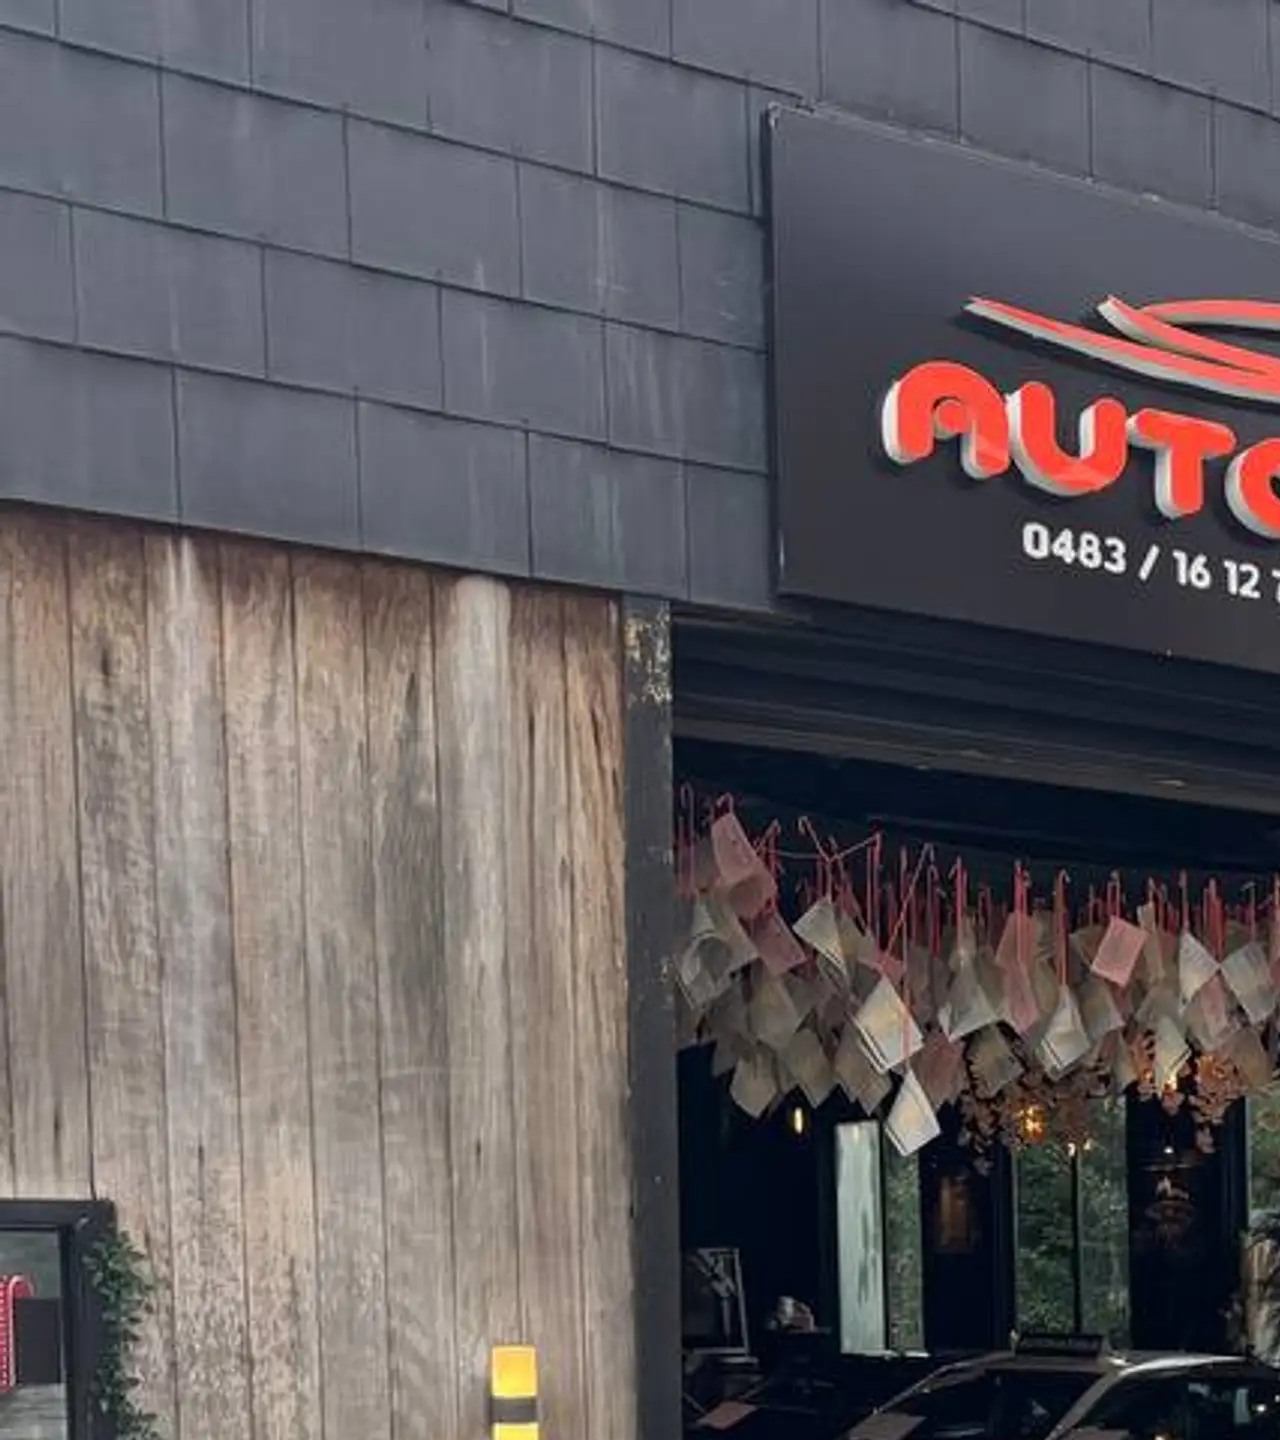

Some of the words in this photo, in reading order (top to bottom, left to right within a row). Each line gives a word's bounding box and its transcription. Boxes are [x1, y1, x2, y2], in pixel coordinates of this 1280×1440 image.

[1022, 522, 1126, 573] 0483
[1138, 545, 1160, 581] /
[1173, 550, 1211, 588] 16
[1224, 560, 1260, 599] 12
